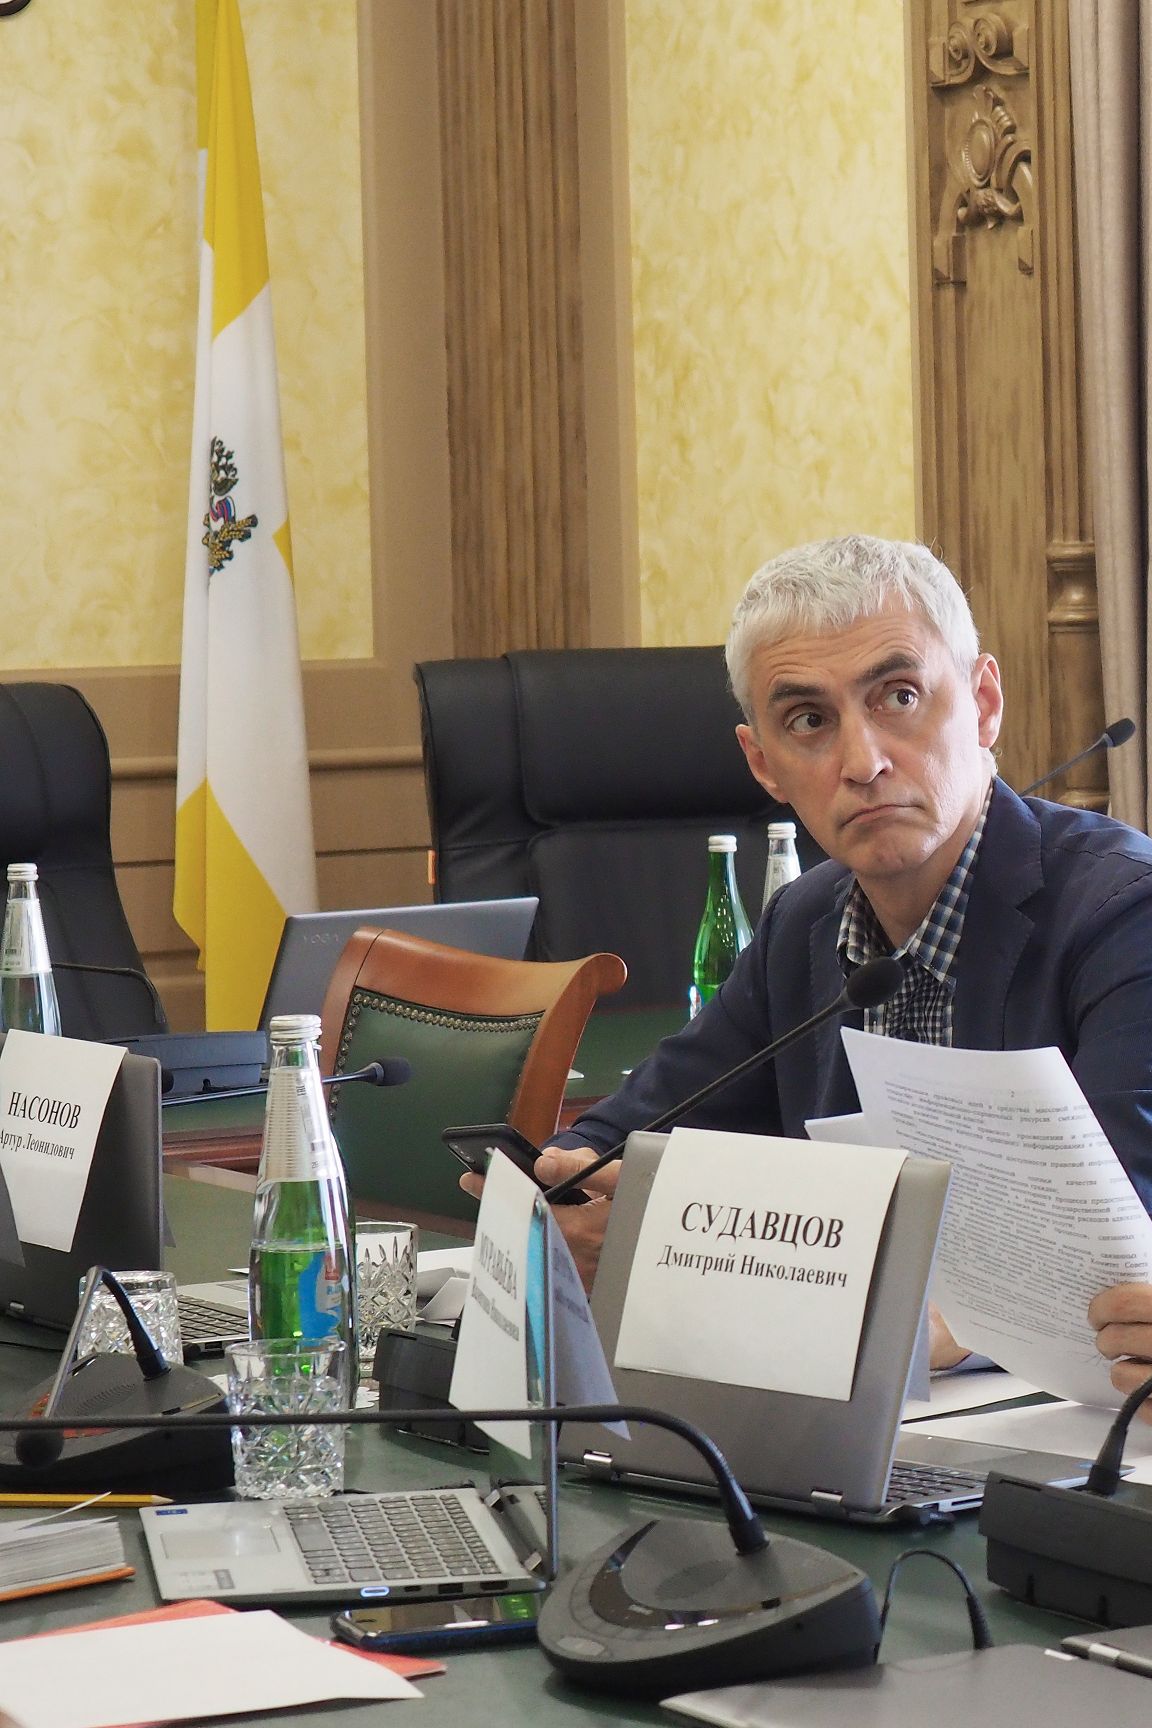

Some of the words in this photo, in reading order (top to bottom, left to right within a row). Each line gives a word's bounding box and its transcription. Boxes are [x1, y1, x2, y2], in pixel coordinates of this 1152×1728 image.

[8, 1091, 81, 1129] НАСОНОВ
[0, 1129, 23, 1153] Артур
[22, 1132, 75, 1160] Леонидович
[681, 1202, 844, 1252] СУДАВЦОВ
[657, 1245, 735, 1276] Дмитрий
[740, 1255, 848, 1288] Николаевич
